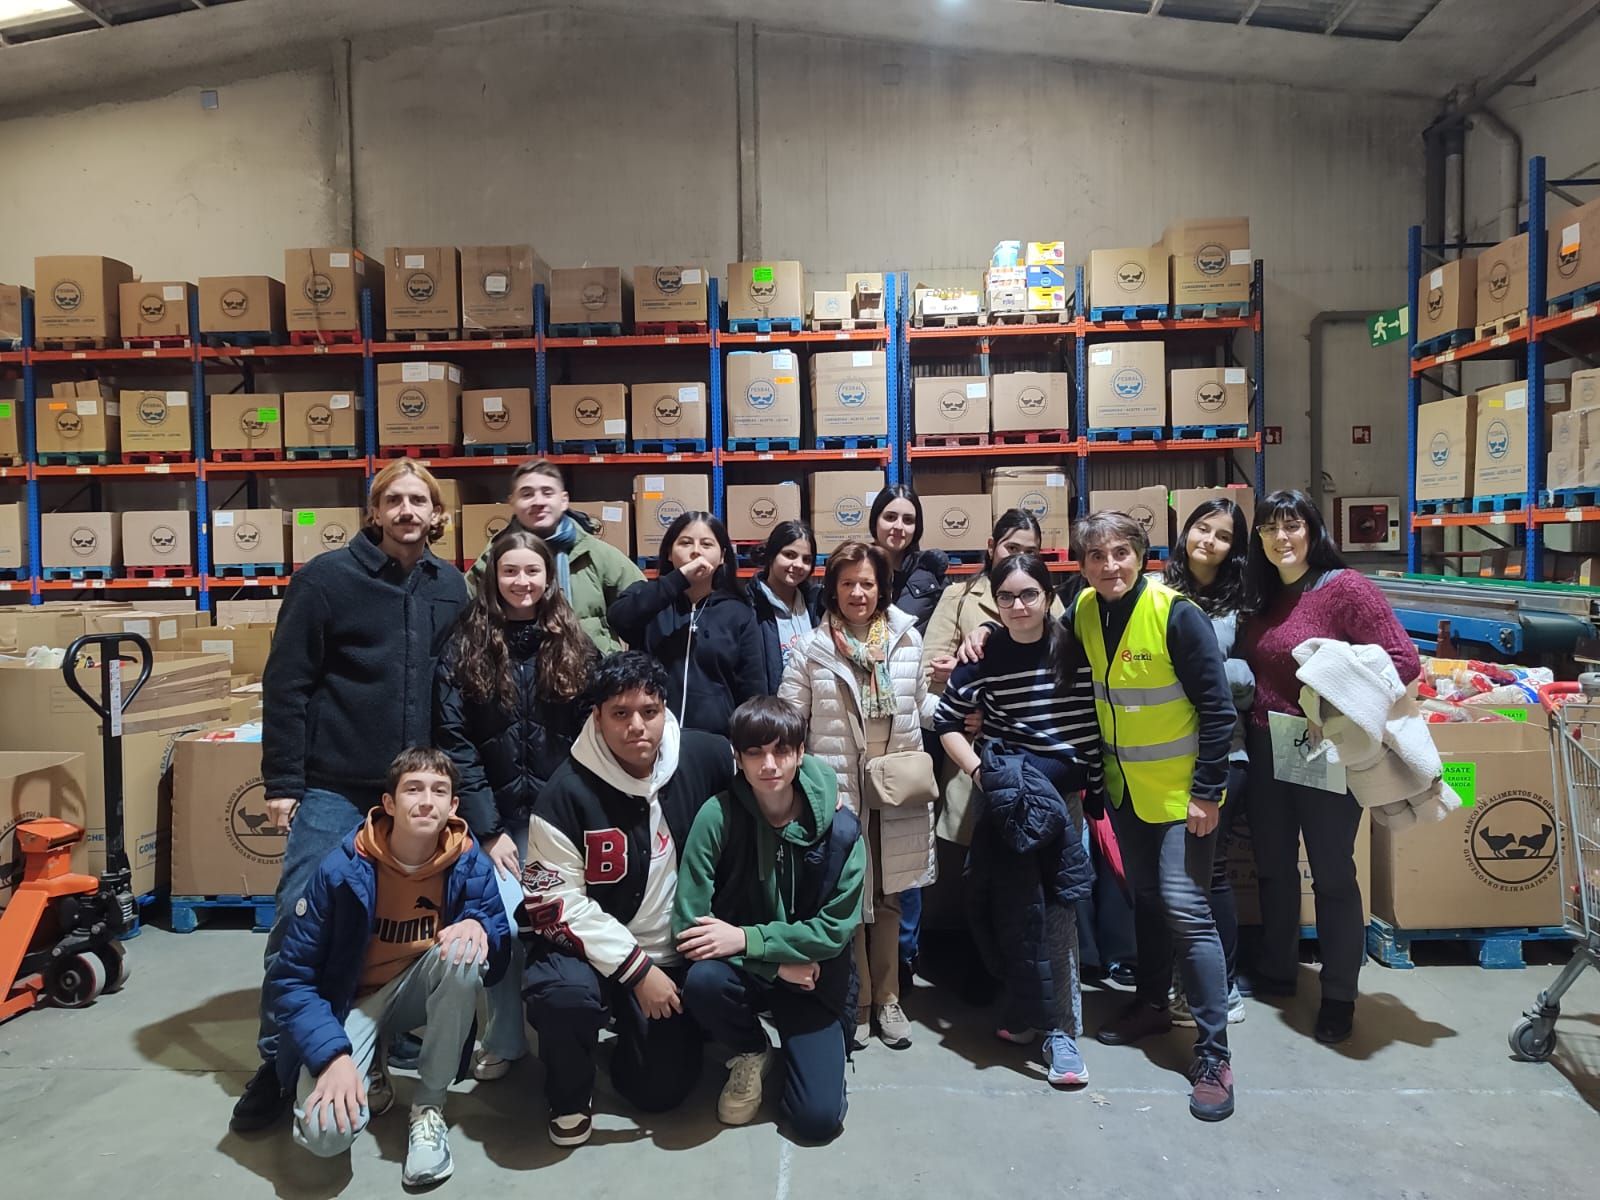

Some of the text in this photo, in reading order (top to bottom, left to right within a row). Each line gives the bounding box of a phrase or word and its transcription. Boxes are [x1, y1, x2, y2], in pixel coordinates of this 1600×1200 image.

[1464, 811, 1479, 834] BANCO
[1489, 789, 1532, 804] ALIMENTOS
[1532, 793, 1542, 802] DE
[88, 834, 104, 842] CHE
[584, 827, 628, 885] B
[1463, 848, 1498, 889] GIPUZKOAKO
[1499, 874, 1549, 893] ELIKAGAIEN
